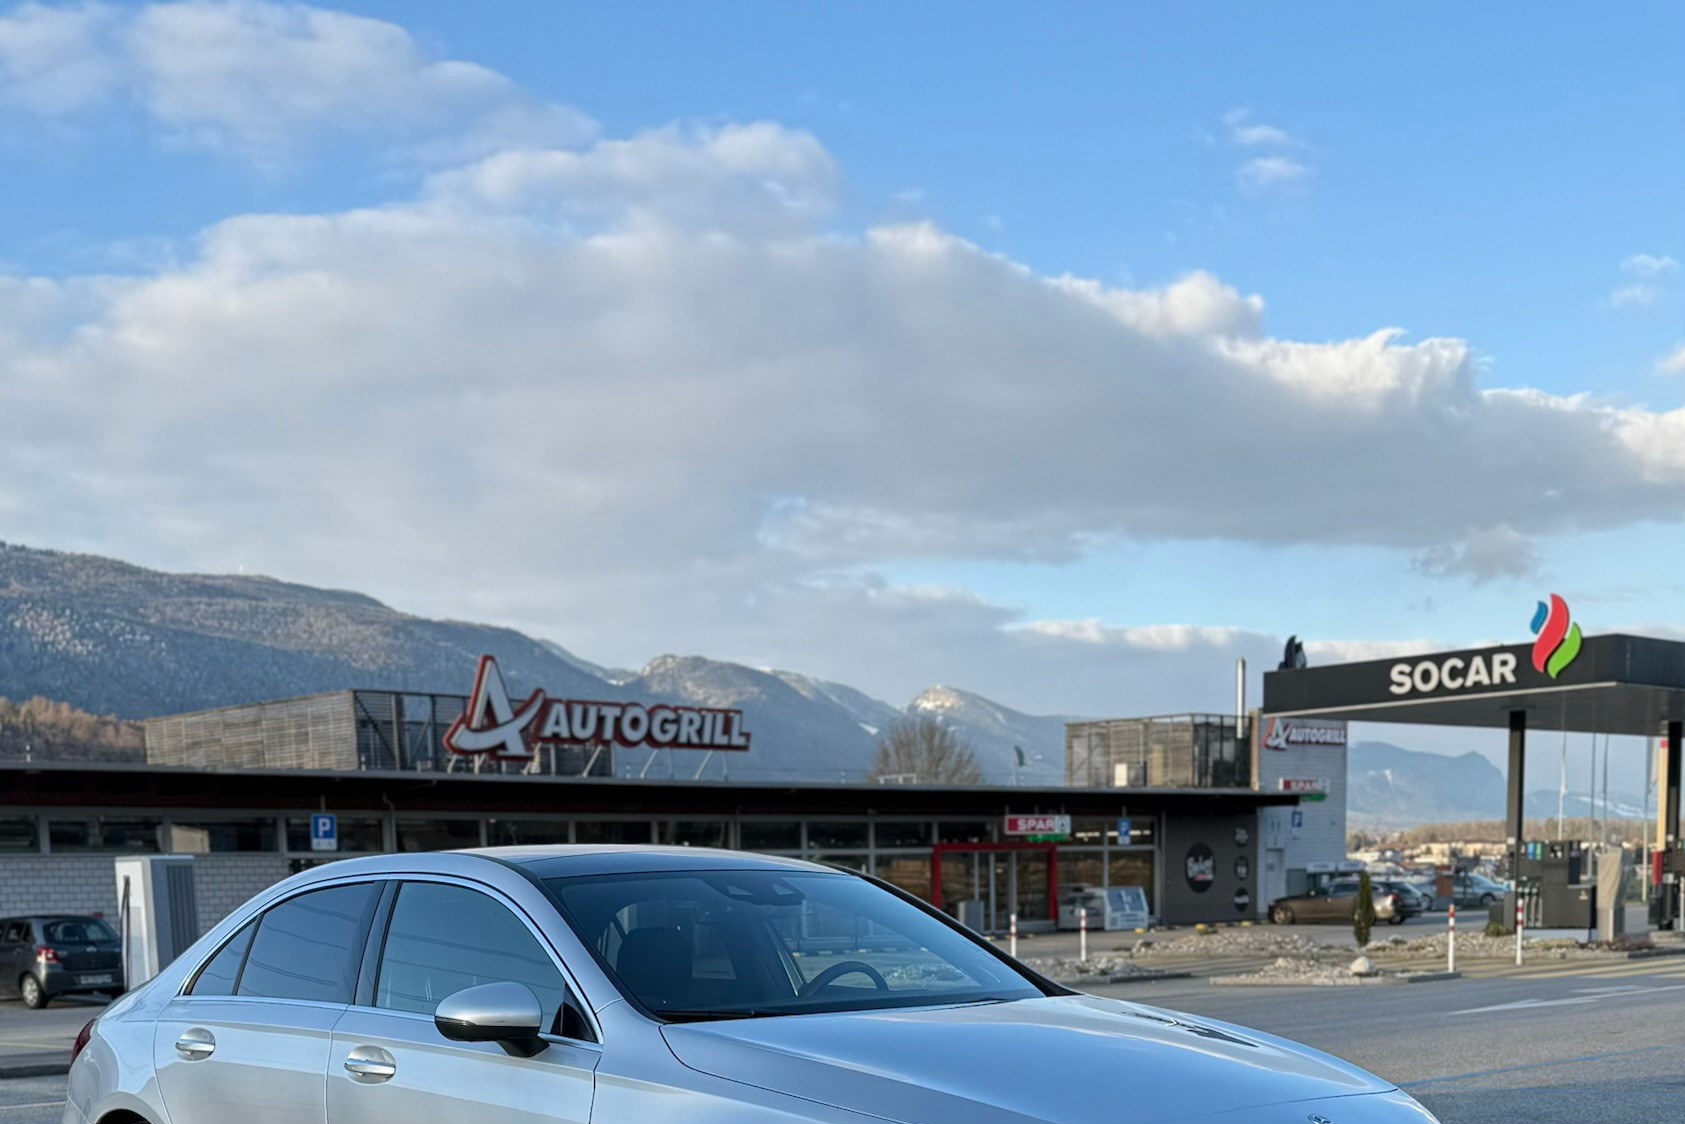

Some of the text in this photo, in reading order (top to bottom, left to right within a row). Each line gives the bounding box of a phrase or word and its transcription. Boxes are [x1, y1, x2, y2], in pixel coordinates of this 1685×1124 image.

[1388, 652, 1517, 695] SOCAR
[541, 702, 748, 746] AUTOGRILL
[1288, 727, 1345, 744] AUTOGRILL
[317, 817, 332, 838] P
[1017, 818, 1055, 832] SPAR
